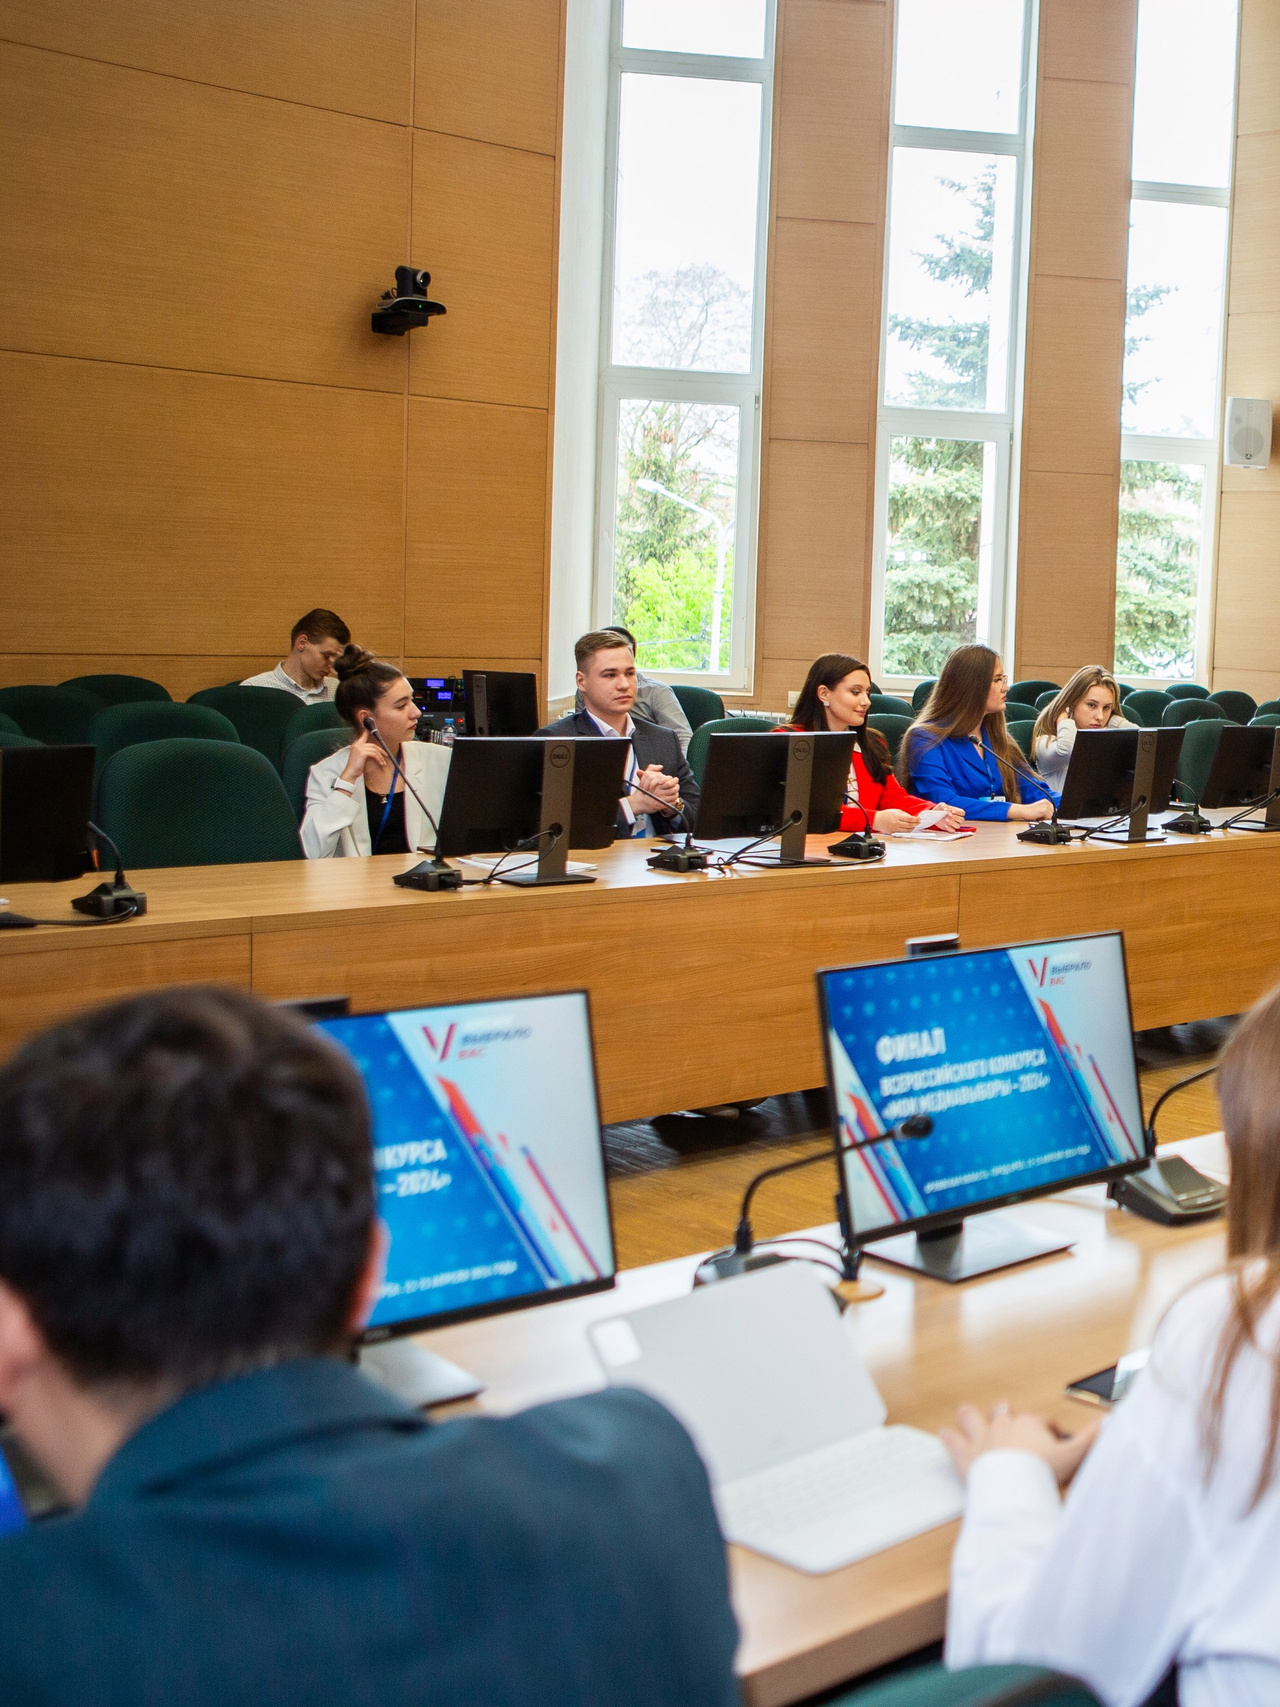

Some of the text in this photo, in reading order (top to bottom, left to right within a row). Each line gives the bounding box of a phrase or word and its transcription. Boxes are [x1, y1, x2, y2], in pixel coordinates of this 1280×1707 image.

[1051, 960, 1093, 975] ВЫБРАЛО
[876, 1027, 947, 1065] ФИНАЛ
[879, 1047, 1048, 1097] ВСЕРОССИЙСКОГО КОНКУРСА
[917, 1078, 1012, 1115] МЕДИАВЫБОРЫ
[375, 1138, 448, 1171] КУРСА
[397, 1169, 452, 1198] 2024»
